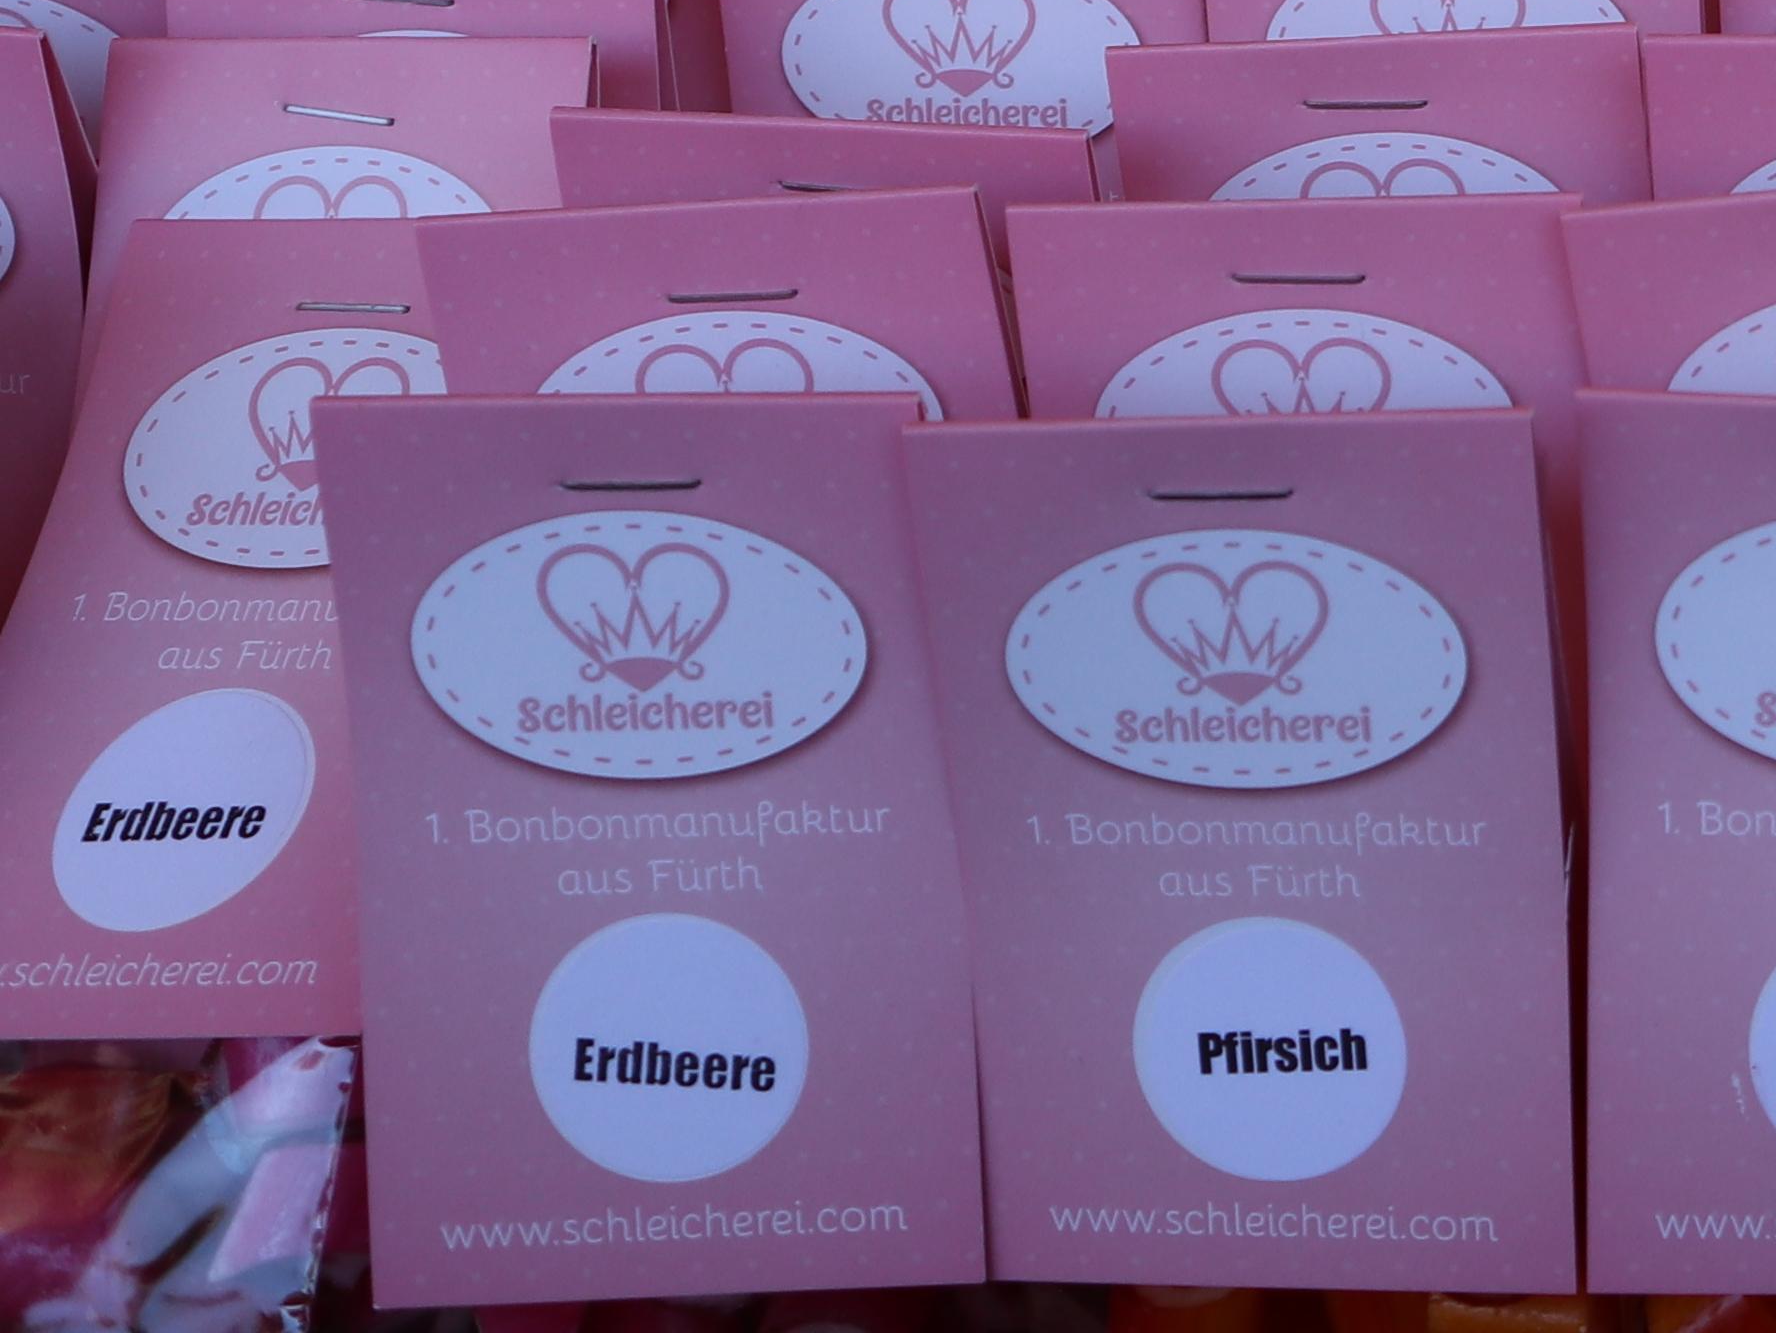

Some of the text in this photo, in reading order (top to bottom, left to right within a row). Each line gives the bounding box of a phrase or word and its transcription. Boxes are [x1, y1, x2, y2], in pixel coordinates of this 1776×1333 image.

[157, 640, 332, 672] aus Fürth
[518, 691, 776, 734] Schleicherei
[1114, 704, 1373, 745] Schleicherei
[80, 800, 268, 844] Erdbeere
[425, 802, 891, 848] 1. Bonbonmanufaktur
[1026, 812, 1488, 857] 1. Bonbonmanufaktur
[1656, 802, 1682, 835] 1.
[558, 859, 765, 899] aus Fürth
[1158, 863, 1362, 900] aus Fürth
[573, 1036, 777, 1093] Erdbeere
[1198, 1027, 1369, 1076] Pfirsich
[440, 1199, 909, 1252] www.schleicherei.com
[1050, 1201, 1500, 1244] www.schleicherei.com
